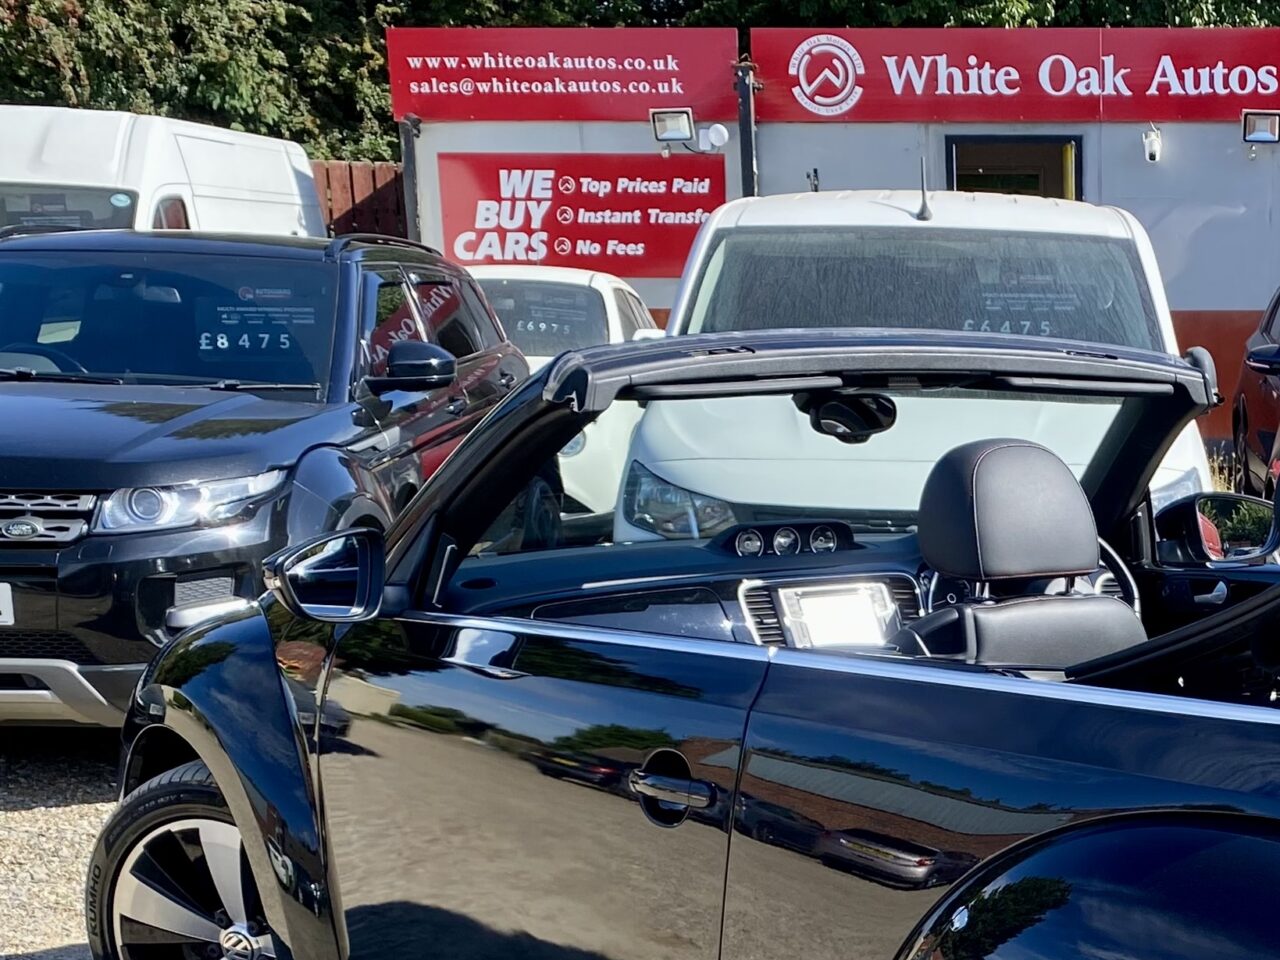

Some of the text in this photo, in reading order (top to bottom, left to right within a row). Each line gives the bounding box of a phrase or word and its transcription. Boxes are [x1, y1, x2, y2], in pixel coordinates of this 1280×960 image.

[405, 51, 680, 71] www.whiteoakautos.co.uk
[882, 53, 1279, 96] White Oak Autos
[409, 77, 685, 96] sales@whiteoakautos.co.uk
[499, 169, 556, 200] WE
[579, 177, 711, 196] Top Prices Paid
[474, 200, 552, 230] BUY
[577, 208, 710, 225] Instant Transfe
[453, 231, 549, 261] CARS
[576, 239, 645, 255] No Fees
[516, 320, 571, 335] £6975
[962, 319, 1051, 336] £6475
[199, 332, 290, 350] £8475
[88, 863, 102, 938] KUMHO
